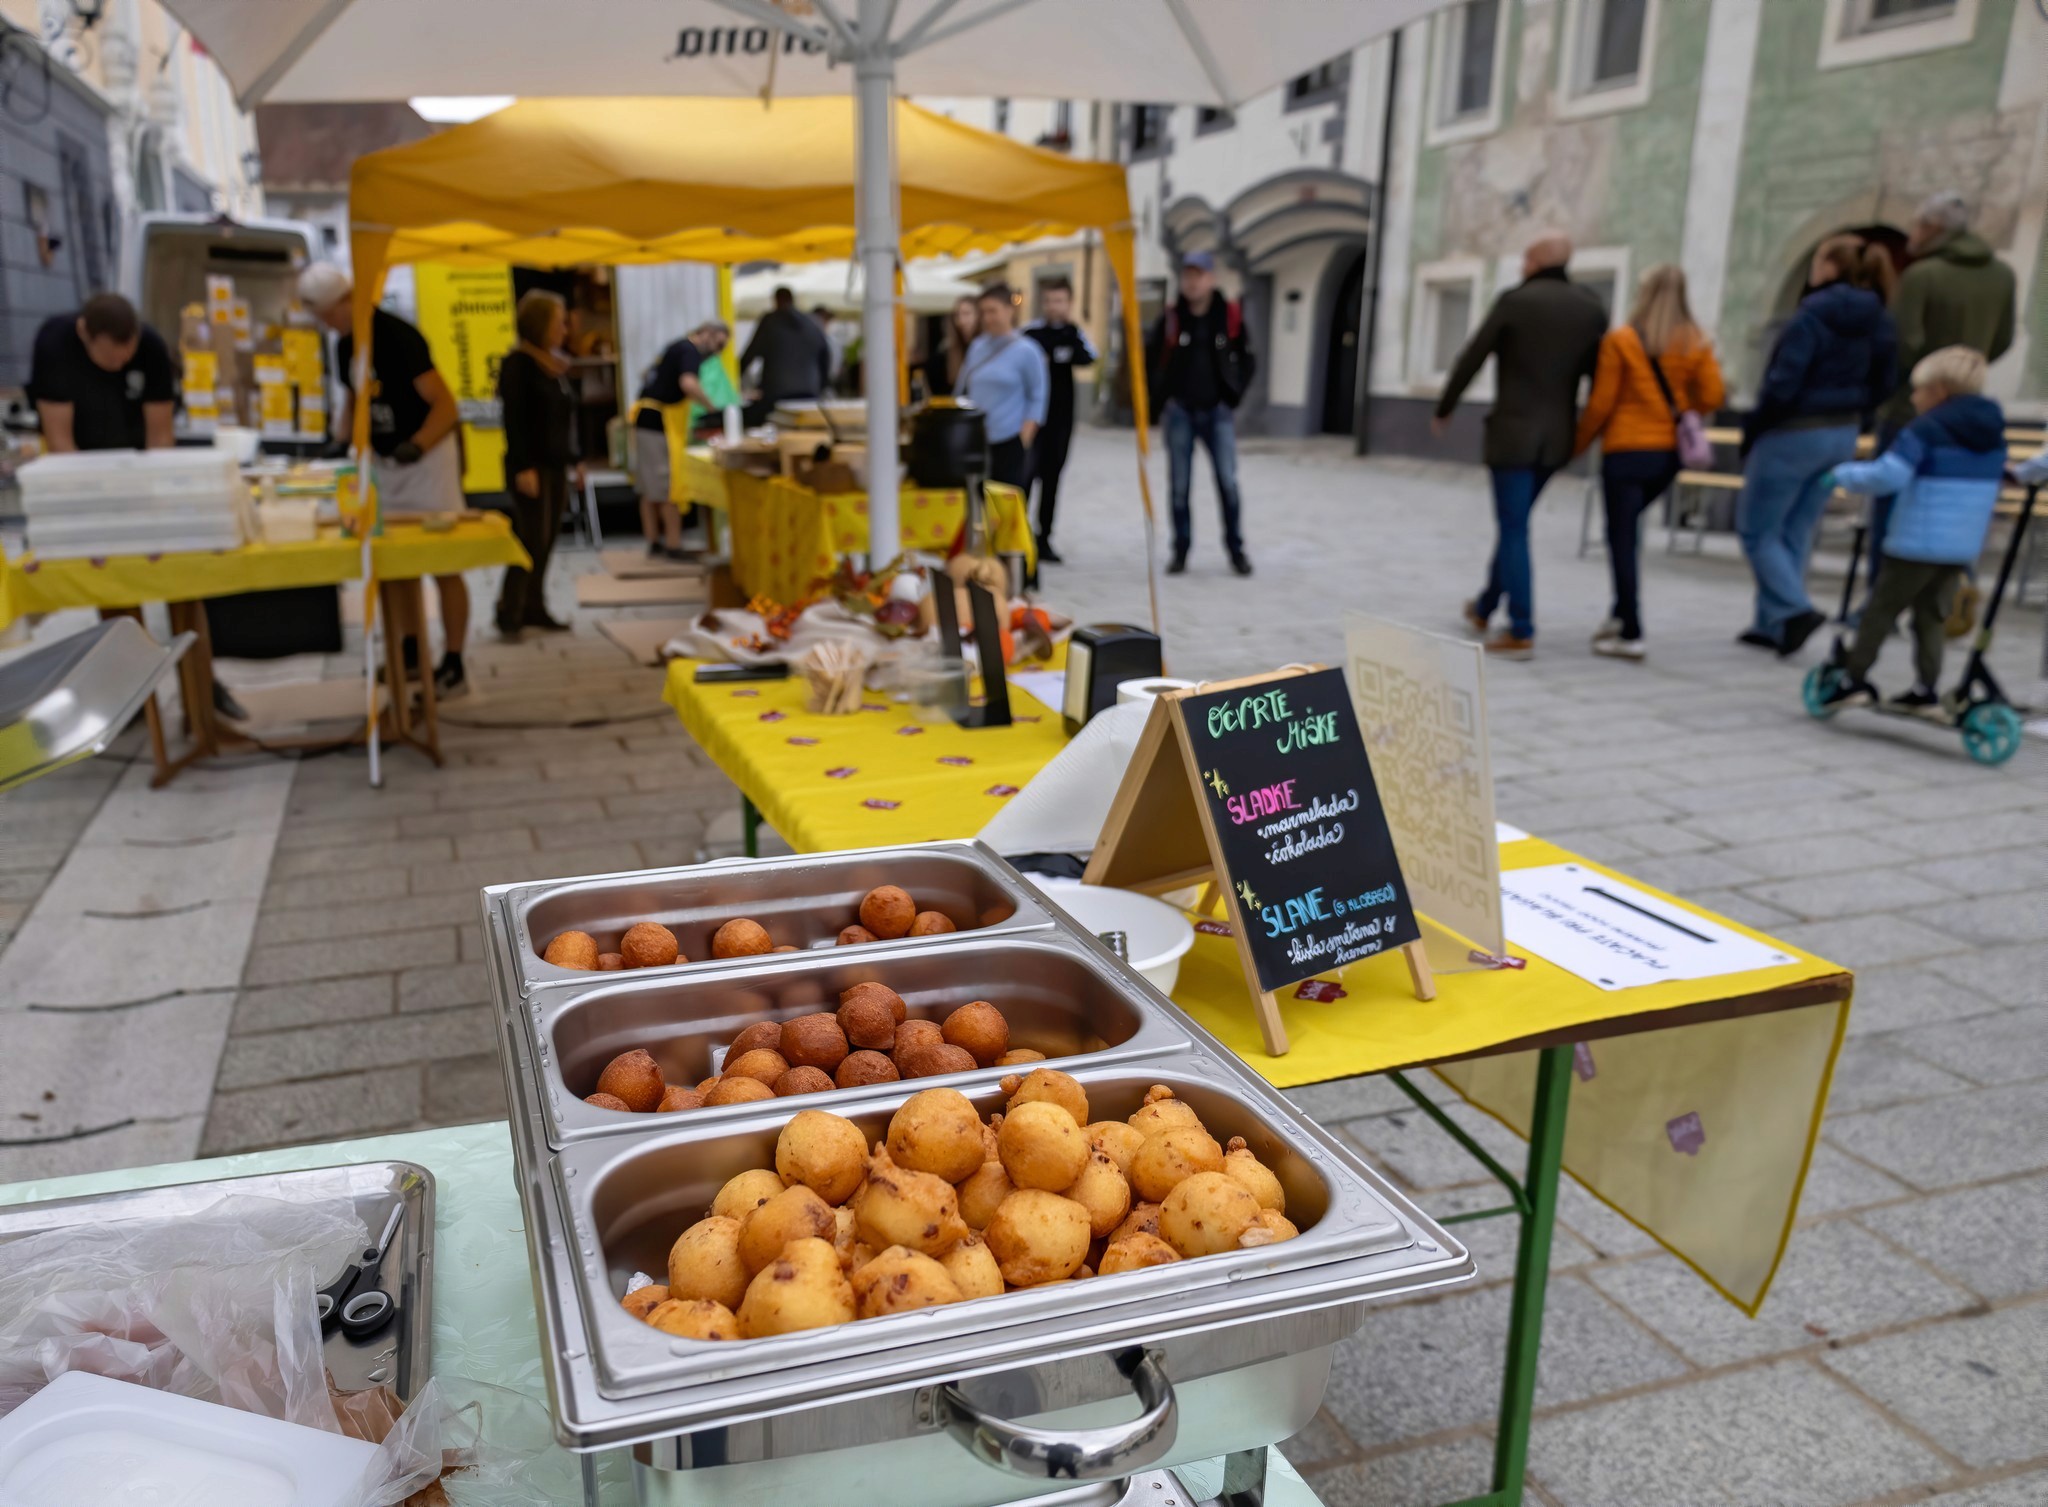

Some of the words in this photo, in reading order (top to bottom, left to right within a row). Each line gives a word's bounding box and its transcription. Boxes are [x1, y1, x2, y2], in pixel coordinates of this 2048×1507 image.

[1207, 689, 1293, 739] OCVRTE
[1227, 778, 1301, 824] SLADKE
[1263, 789, 1360, 839] marmelada
[1270, 822, 1345, 865] čokolada
[1261, 886, 1332, 938] SLANE
[1291, 934, 1327, 965] kisla
[1325, 918, 1382, 953] smetana
